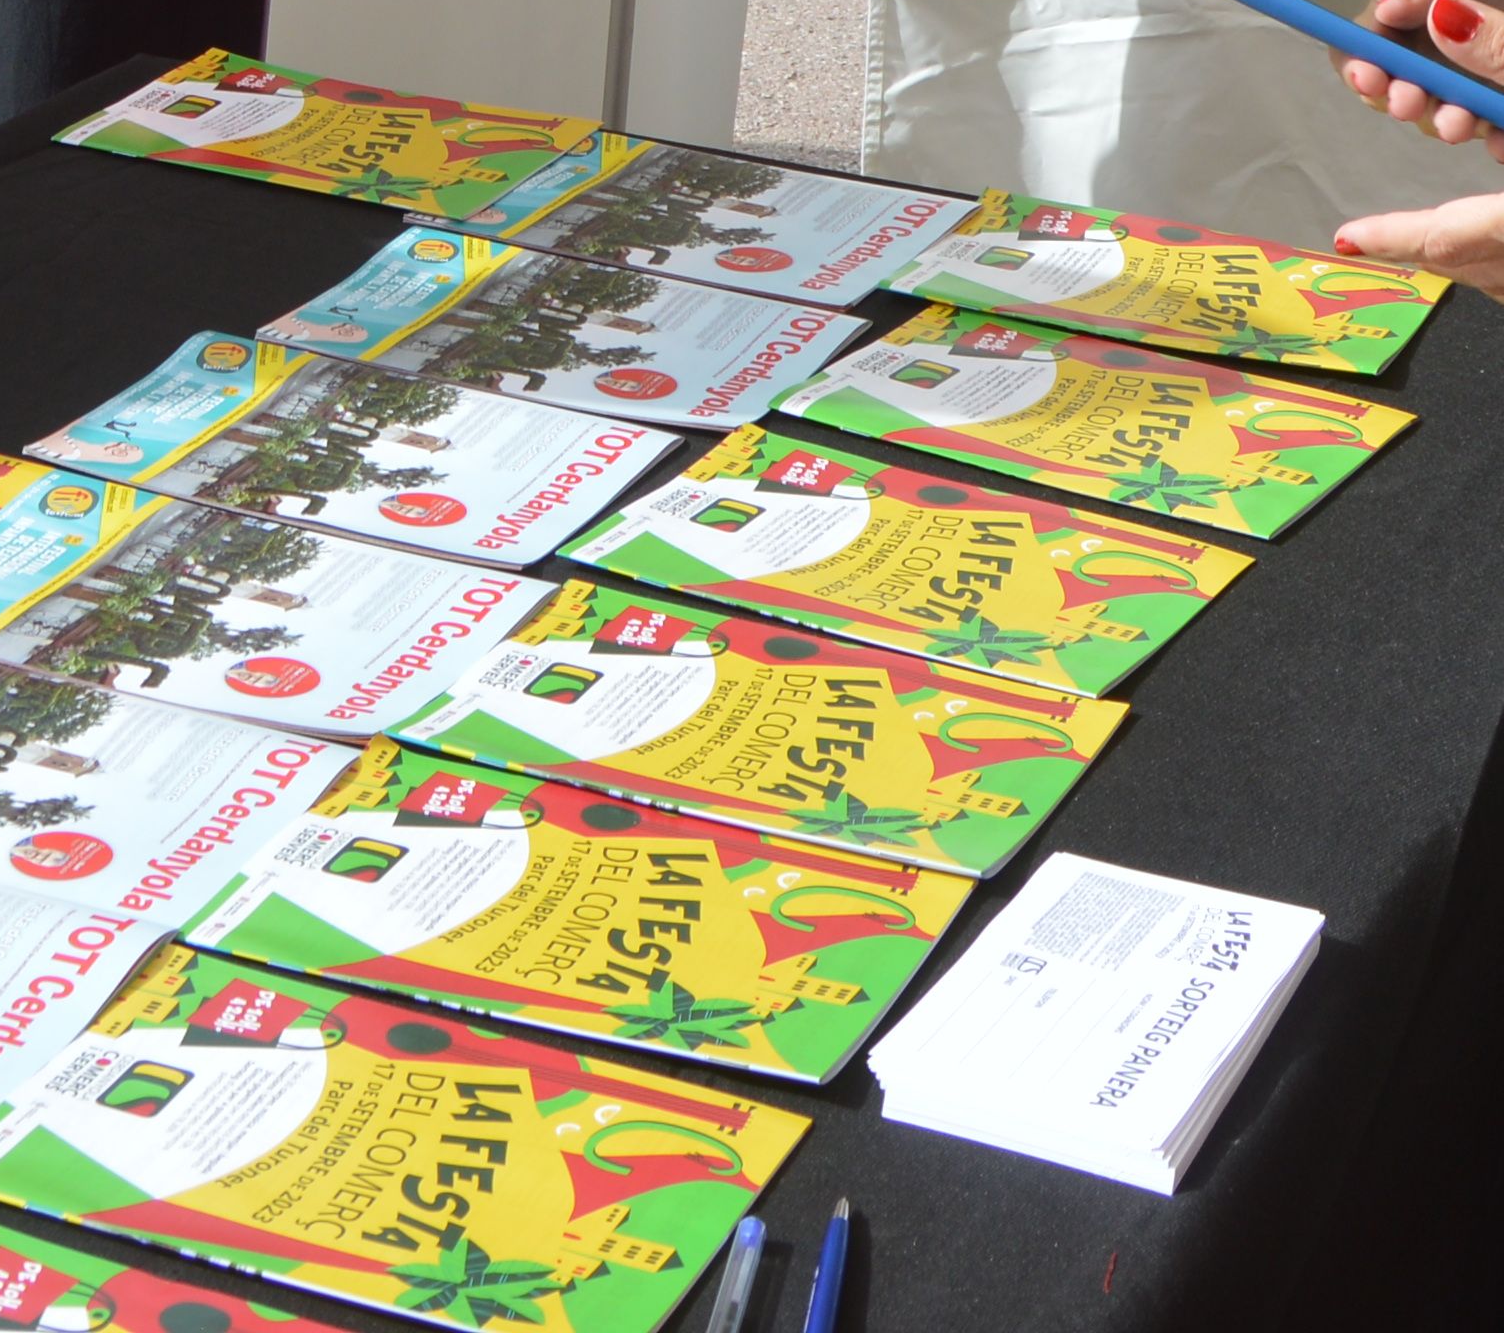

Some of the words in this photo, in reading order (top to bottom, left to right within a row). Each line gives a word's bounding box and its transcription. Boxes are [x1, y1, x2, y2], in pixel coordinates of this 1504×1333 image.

[338, 108, 379, 125] DEL
[377, 112, 423, 129] LA
[275, 126, 356, 167] COMERÇ
[313, 130, 410, 174] FESTA
[891, 198, 949, 227] TOT
[796, 225, 912, 291] Cerdanyola
[1174, 252, 1207, 273] DEL
[1210, 255, 1258, 274] LA
[1134, 276, 1195, 325] COMERÇ
[1180, 280, 1261, 331] FESTA
[776, 310, 837, 344] TOT
[682, 341, 802, 420] Cerdanyola
[1102, 376, 1147, 399] DEL
[1148, 383, 1199, 406] LA
[579, 425, 647, 466] TOT
[1036, 405, 1122, 461] COMERÇ
[1083, 410, 1189, 469] FESTA
[469, 459, 606, 553] Cerdanyola
[917, 513, 967, 541] DEL
[966, 519, 1024, 547] LA
[847, 545, 940, 612] COMERÇ
[897, 552, 1013, 623] FESTA
[448, 577, 520, 623] TOT
[321, 618, 470, 728] Cerdanyola
[710, 678, 739, 703] Parc
[747, 680, 763, 692] DE
[754, 667, 773, 680] 17
[771, 673, 820, 706] DEL
[694, 704, 722, 721] del
[823, 678, 881, 709] LA
[705, 692, 761, 746] SETEMBRE
[629, 722, 705, 757] Turonet
[693, 745, 713, 758] DE
[700, 711, 795, 793] COMERÇ
[251, 737, 327, 790] TOT
[662, 754, 707, 782] 2023
[756, 717, 872, 804] FESTA
[118, 784, 277, 913] Cerdanyola
[270, 826, 319, 862] SERVEIS
[563, 855, 580, 869] DE
[571, 840, 592, 854] 17
[524, 854, 555, 883] Parc
[589, 847, 642, 884] DEL
[645, 852, 708, 886] LA
[507, 883, 537, 903] del
[519, 869, 579, 930] SETEMBRE
[436, 903, 519, 944] Turonet
[505, 929, 528, 943] DE
[1226, 911, 1252, 927] LA
[48, 913, 135, 975] TOT
[513, 892, 616, 986] COMERÇ
[574, 896, 699, 996] FESTA
[1199, 930, 1250, 972] FESTA
[472, 942, 520, 975] 2023
[1142, 977, 1215, 1046] SORTEIG
[372, 1062, 395, 1080] 17
[1088, 1045, 1161, 1108] PANERA
[317, 1079, 354, 1114] Parc
[362, 1082, 381, 1099] DE
[387, 1072, 449, 1118] DEL
[449, 1081, 521, 1123] LA
[296, 1116, 329, 1140] del
[305, 1100, 378, 1175] SETEMBRE
[213, 1142, 308, 1191] Turonet
[289, 1175, 314, 1192] DE
[294, 1127, 416, 1242] COMERÇ
[249, 1187, 305, 1227] 2023
[359, 1133, 506, 1255] FESTA
